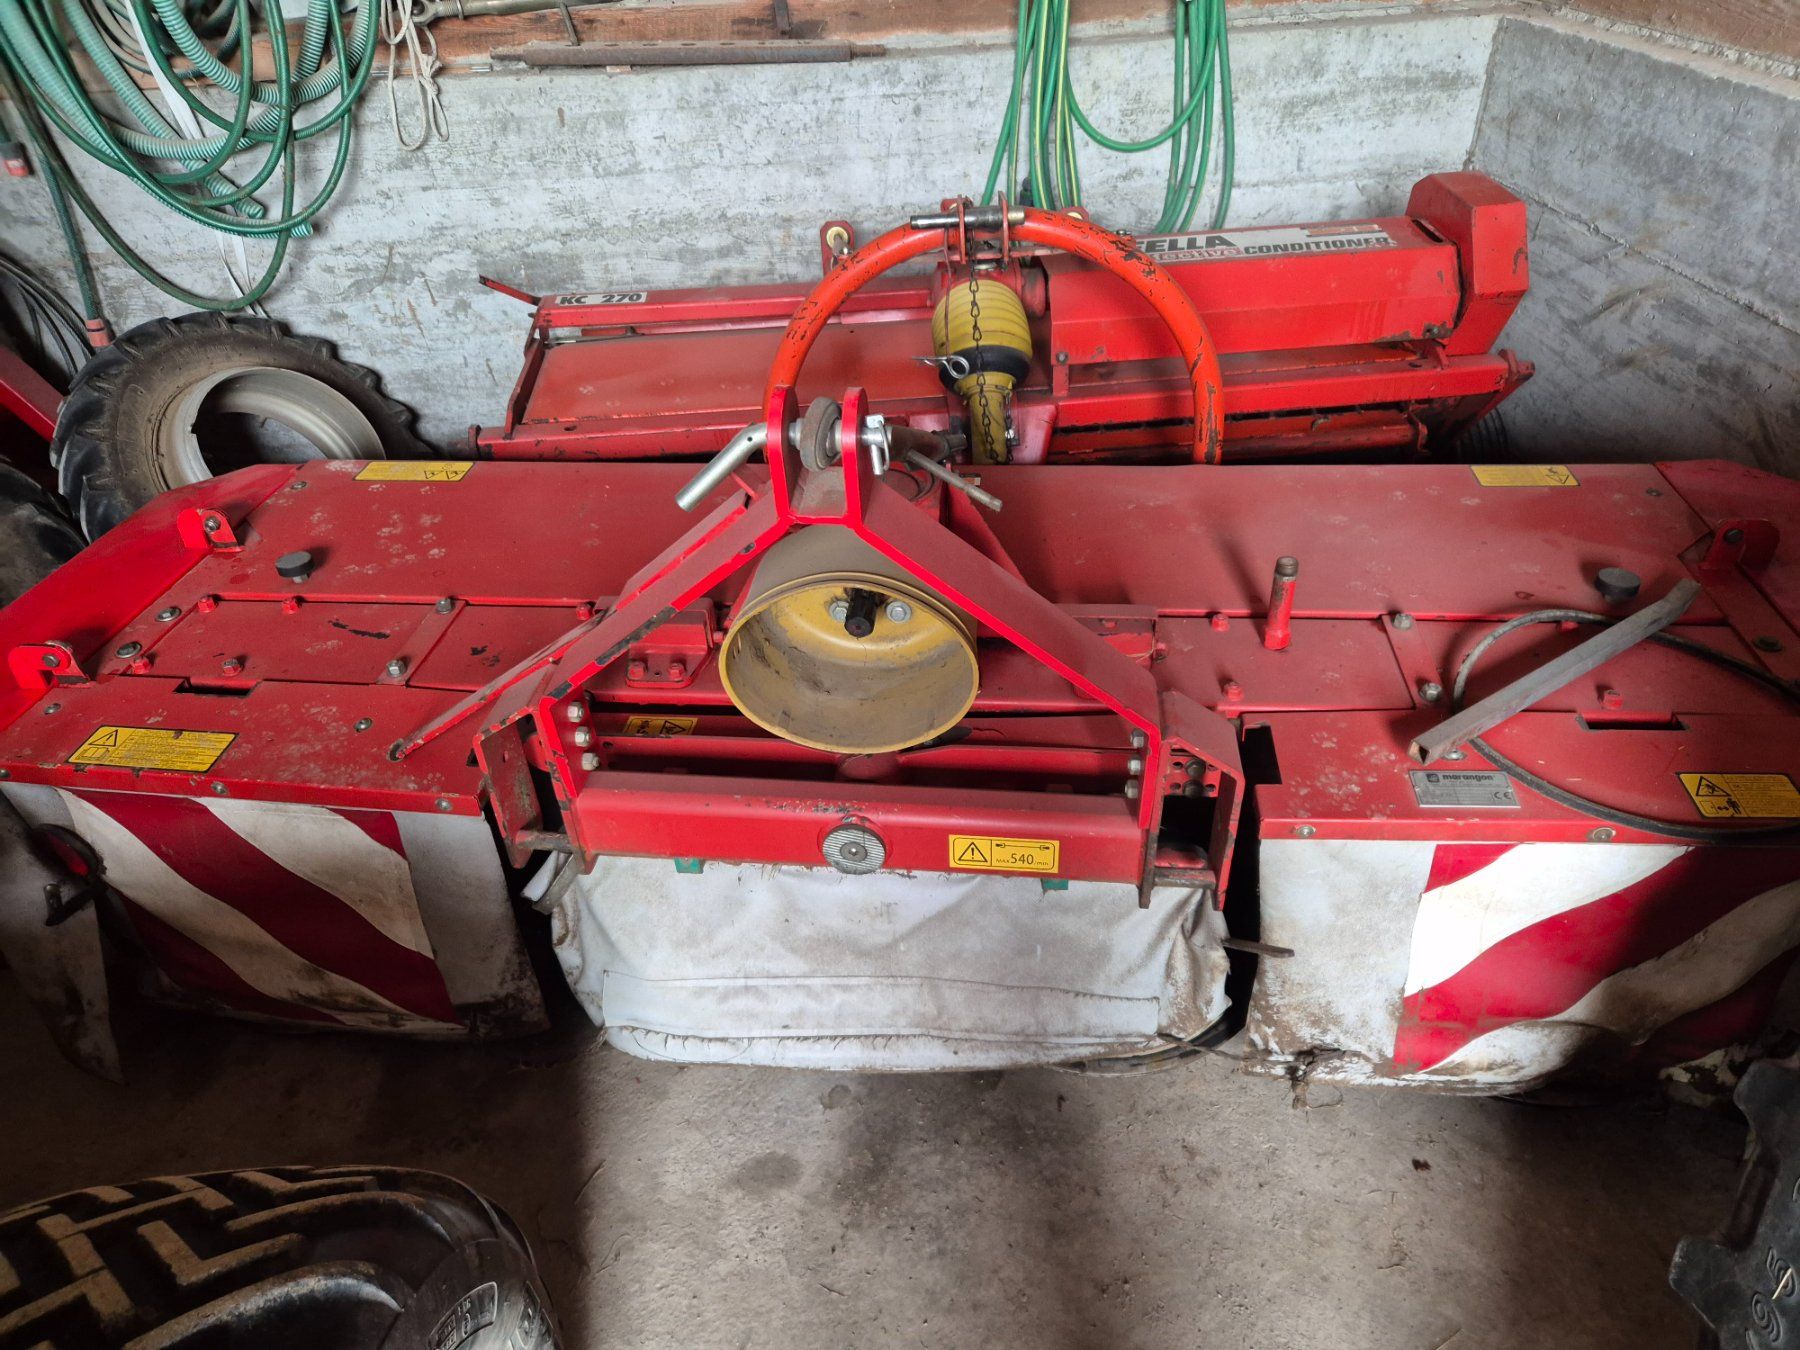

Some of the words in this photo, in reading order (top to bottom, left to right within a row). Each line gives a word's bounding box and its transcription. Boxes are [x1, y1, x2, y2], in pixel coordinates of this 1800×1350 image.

[559, 295, 588, 305] KC
[600, 293, 643, 303] 270
[1442, 774, 1494, 782] marangon
